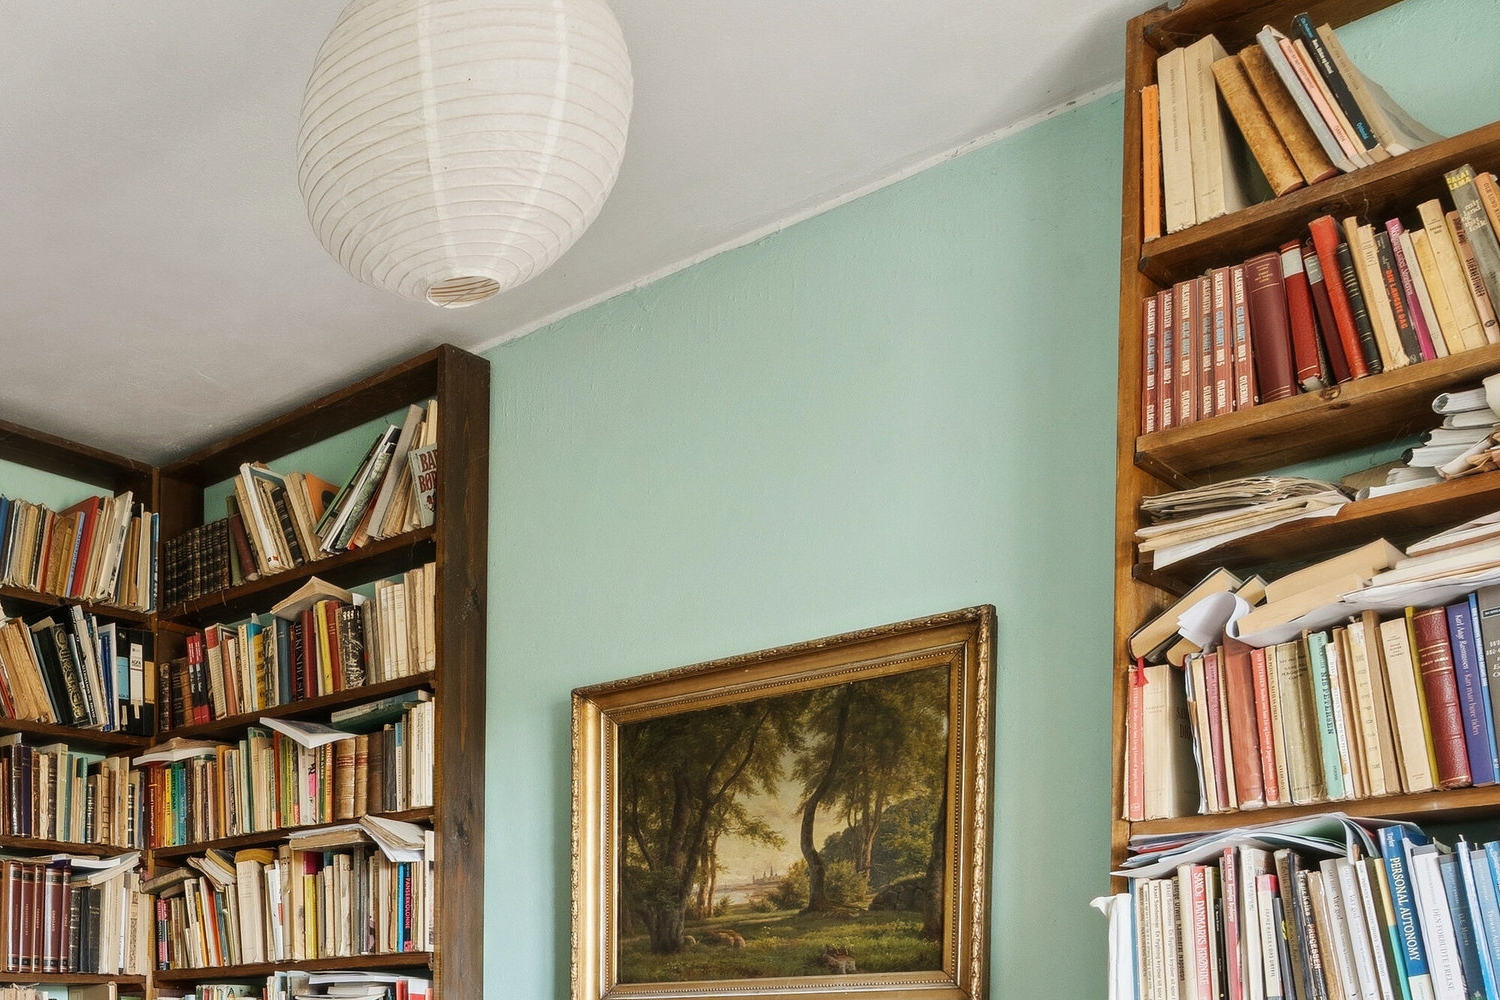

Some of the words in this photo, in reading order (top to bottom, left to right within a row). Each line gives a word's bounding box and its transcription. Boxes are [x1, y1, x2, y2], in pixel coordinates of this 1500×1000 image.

[1446, 170, 1469, 184] DALAI
[1449, 177, 1471, 191] LAMA
[1469, 220, 1487, 232] folk
[1386, 269, 1395, 283] DEN
[1389, 284, 1404, 313] LÆNGSTE
[1398, 315, 1408, 329] DAG
[1458, 641, 1469, 670] Rasmussen
[1322, 688, 1334, 735] PETERSEN
[1387, 832, 1396, 848] Taylor
[1195, 900, 1207, 944] DANMARKS
[1390, 857, 1406, 905] PERSONAL
[1400, 907, 1421, 961] AUTONOMY
[1432, 908, 1442, 924] DEN
[1308, 924, 1321, 969] PROCESSEN
[1436, 925, 1448, 962] FORBUDTE
[1199, 947, 1209, 984] KRØNIKE
[1444, 964, 1455, 991] FRELSE
